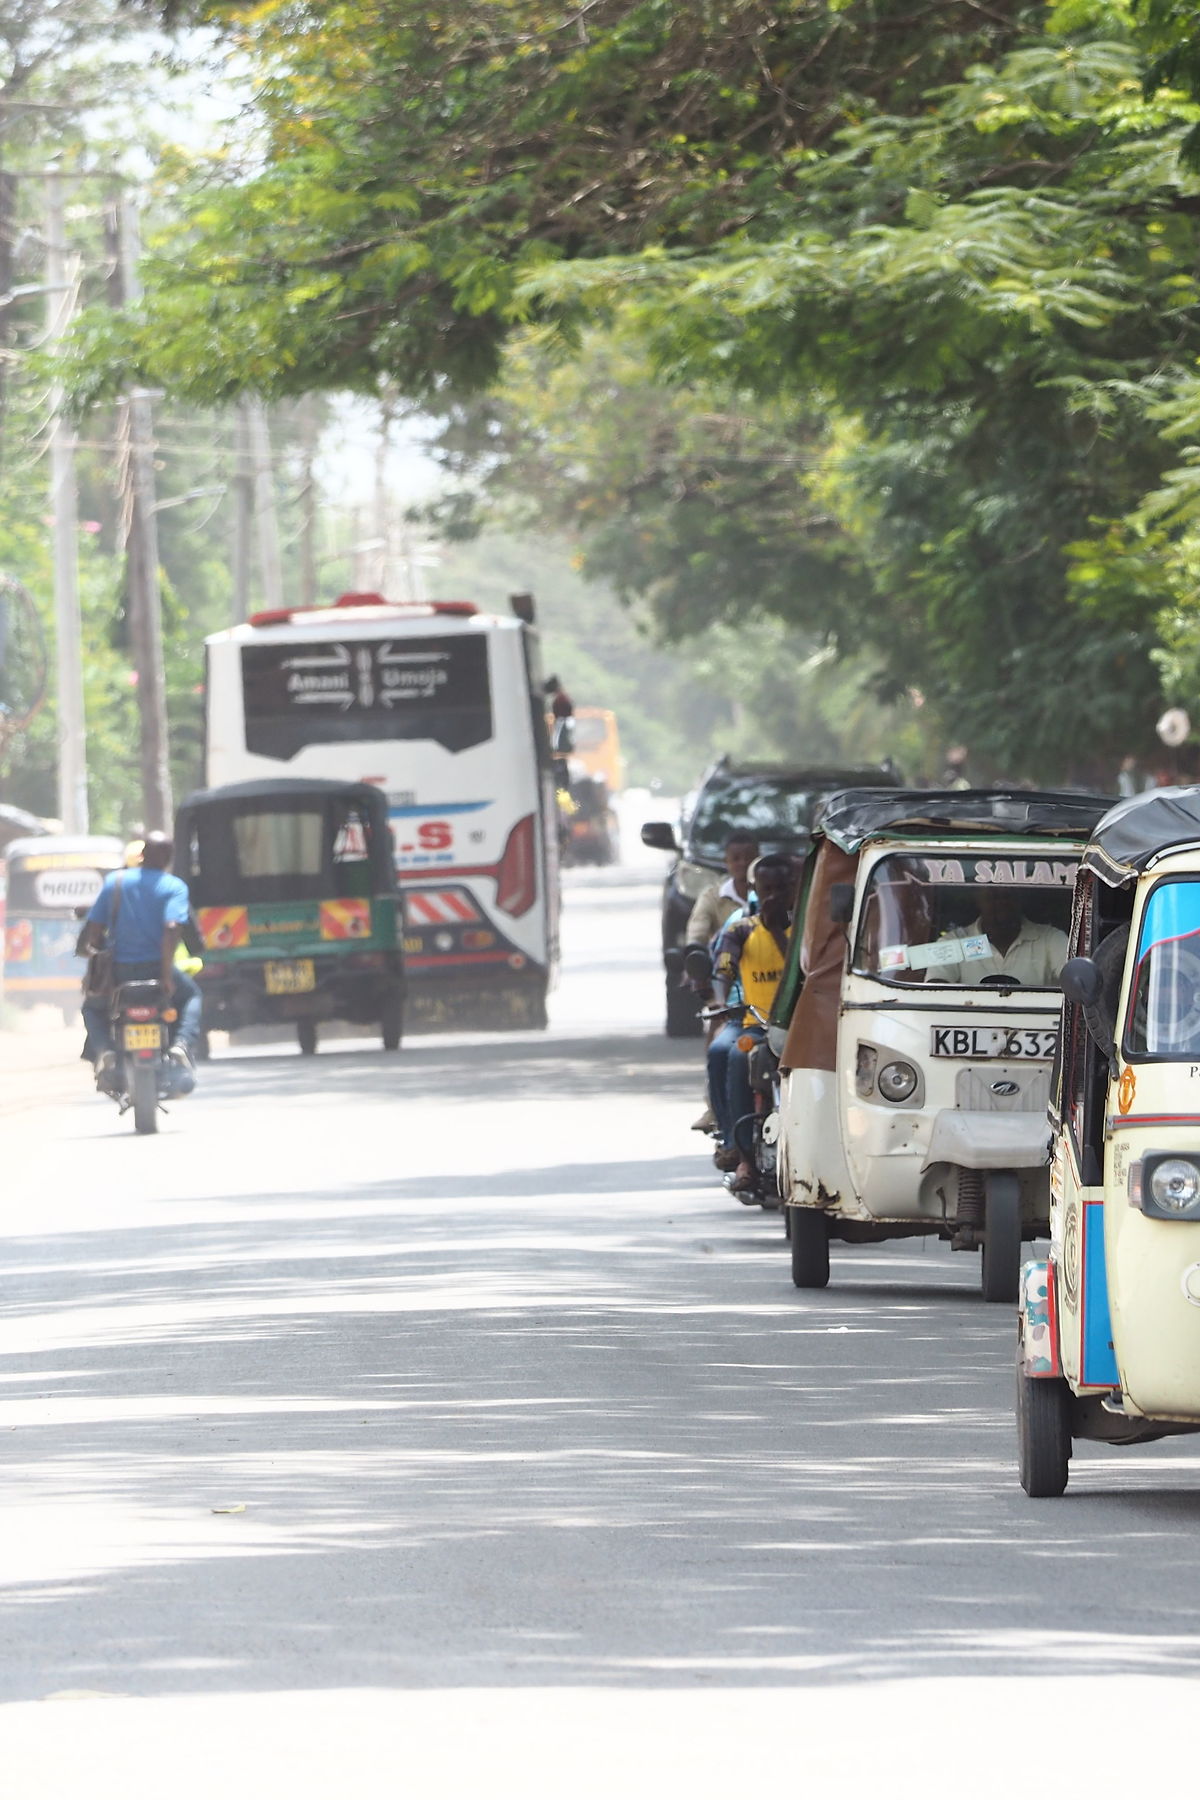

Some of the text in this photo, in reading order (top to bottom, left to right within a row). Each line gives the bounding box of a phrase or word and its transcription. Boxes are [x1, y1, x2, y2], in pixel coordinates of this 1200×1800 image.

[924, 860, 965, 883] YA
[935, 1029, 1057, 1057] KBL 632
